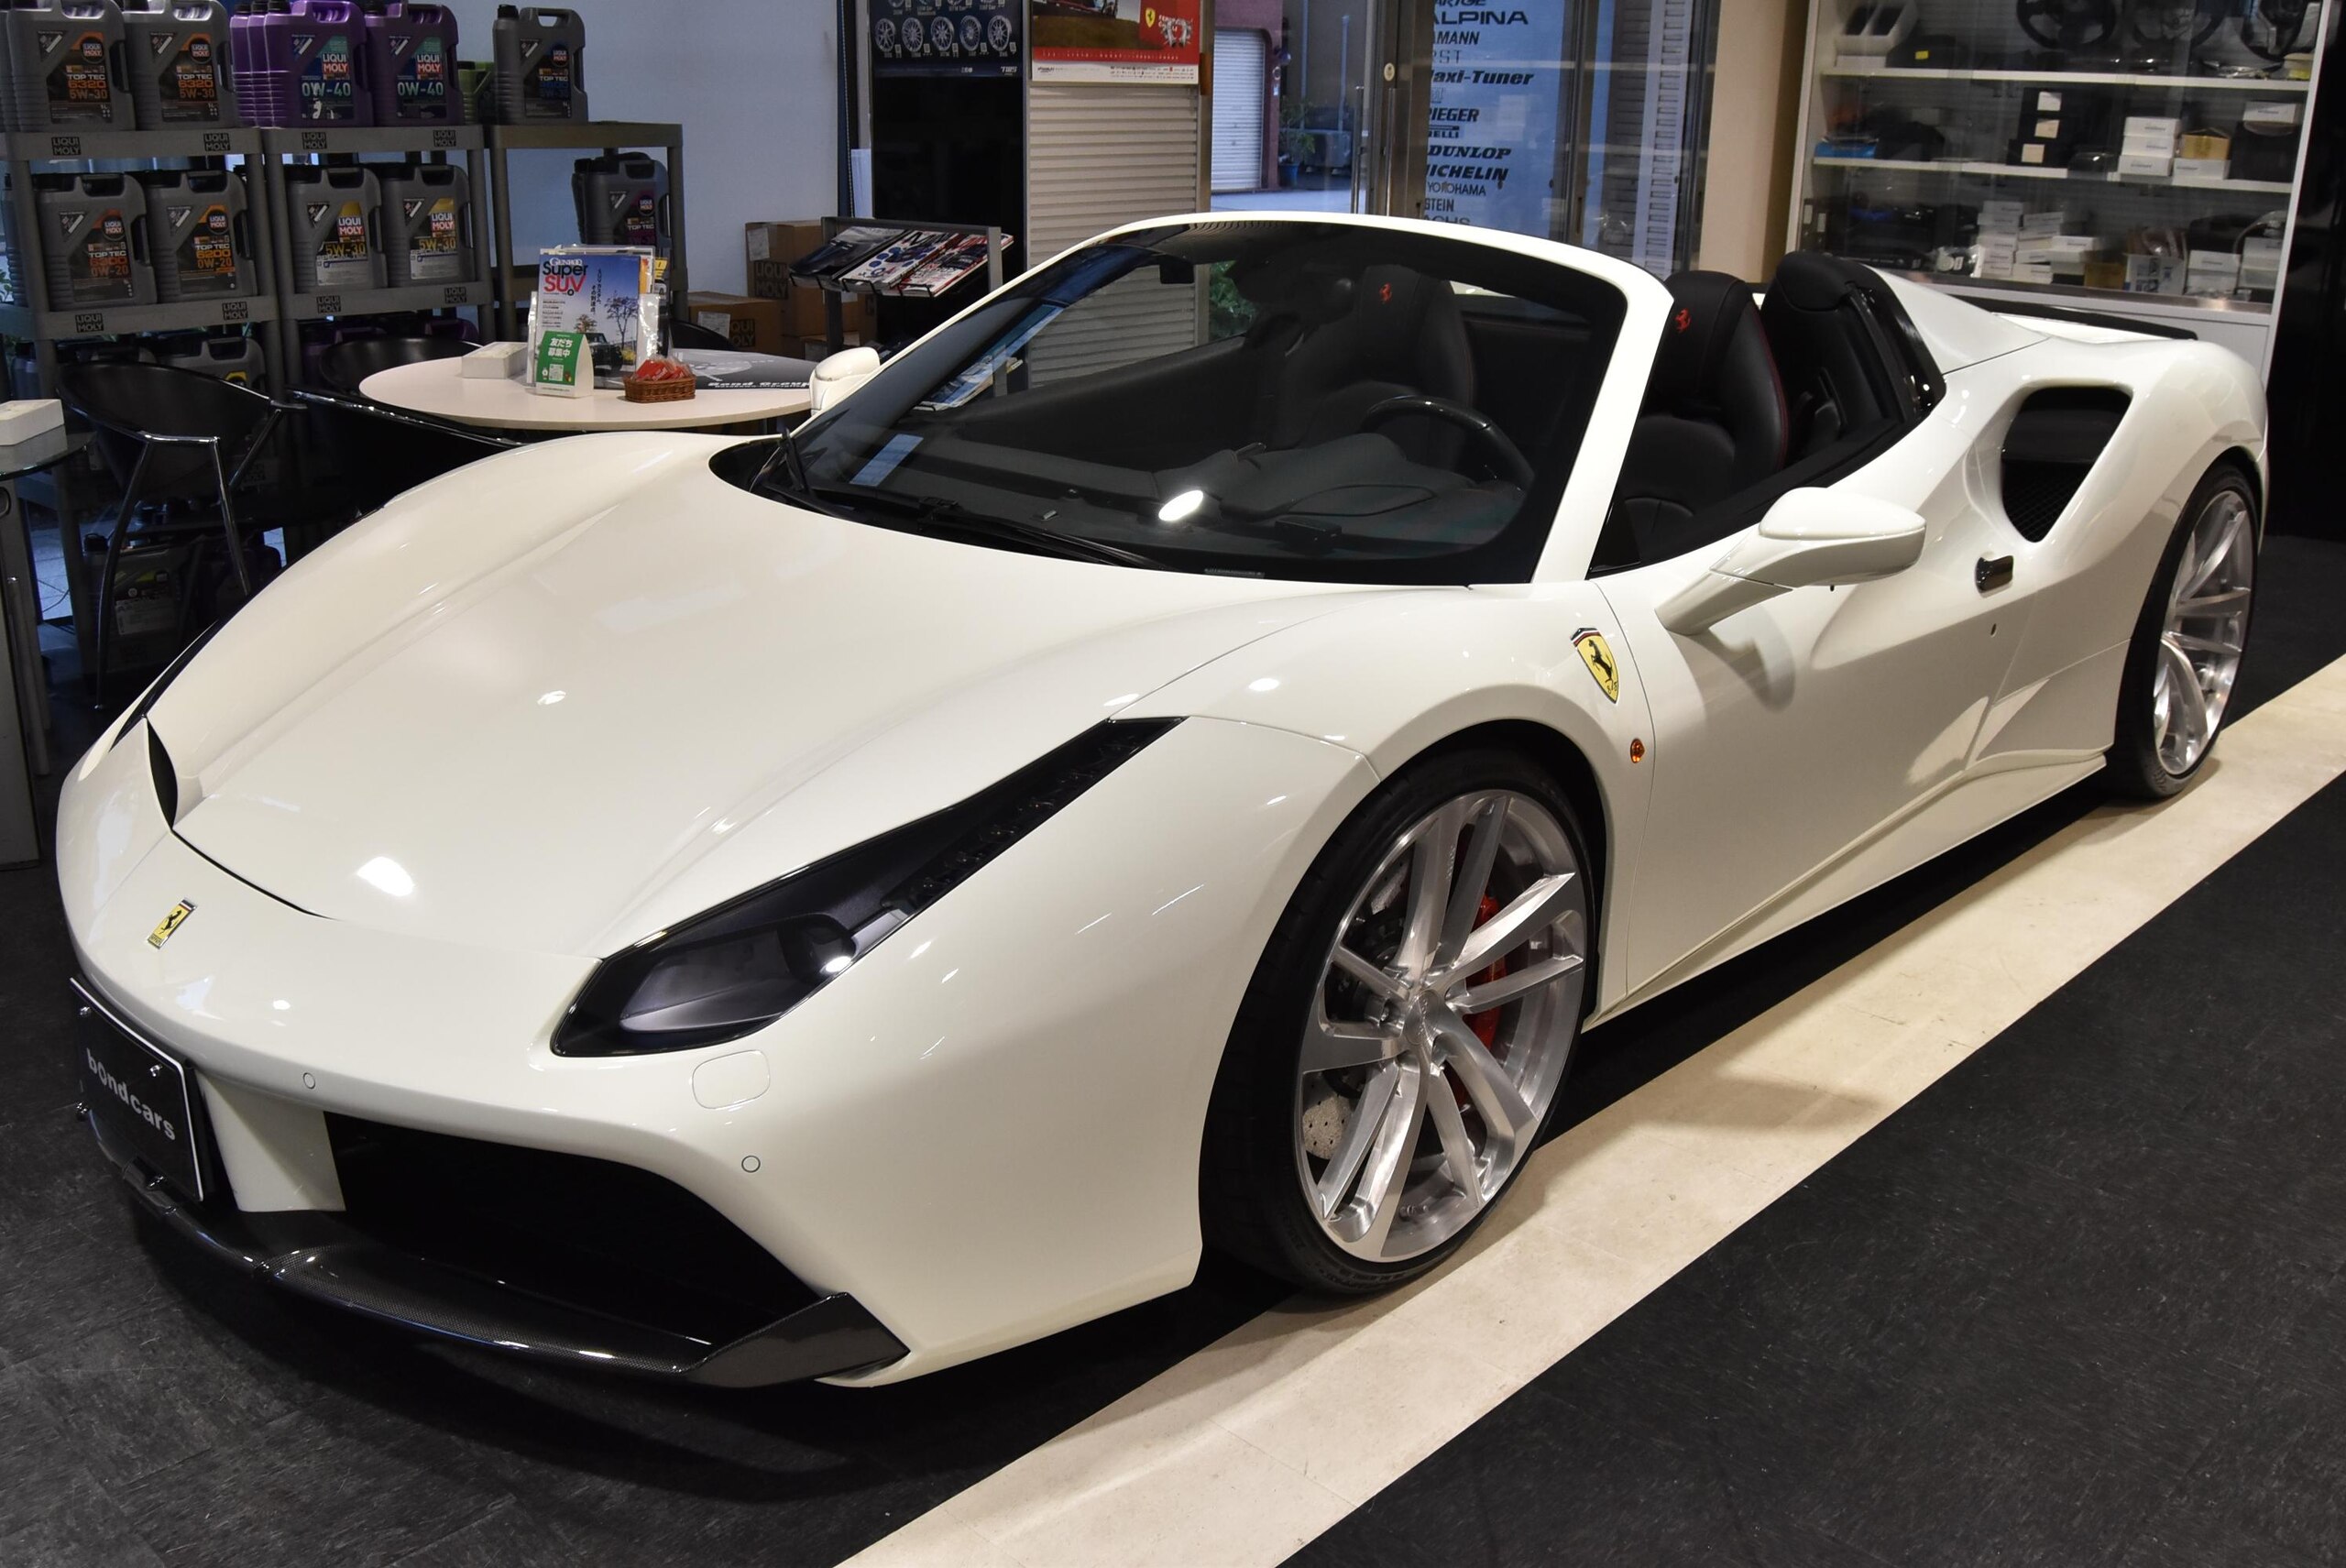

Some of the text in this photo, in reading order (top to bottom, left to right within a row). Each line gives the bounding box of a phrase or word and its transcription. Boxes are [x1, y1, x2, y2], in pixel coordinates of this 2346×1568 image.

[1433, 31, 1480, 45] MANN
[322, 54, 346, 62] LIQUI
[416, 54, 440, 63] LIQUI
[323, 63, 348, 72] MOLY
[417, 63, 441, 72] MOLY
[69, 81, 106, 89] 6320
[301, 82, 351, 97] 0W-40
[397, 82, 444, 97] 0W-40
[70, 89, 107, 100] 5W-30
[180, 88, 214, 99] 5W-30
[204, 134, 229, 143] LIQUI
[303, 132, 326, 140] LIQUI
[53, 137, 79, 146] LIQUI
[303, 140, 327, 149] MOLY
[434, 138, 456, 147] MOLY
[53, 146, 81, 155] MOLY
[205, 142, 230, 151] MOLY
[1427, 145, 1512, 159] DUNLOP
[337, 217, 361, 225] LIQUI
[432, 222, 455, 230] MOLY
[339, 226, 363, 236] MOLY
[419, 237, 456, 250] 5W-30
[196, 250, 231, 258] 6200
[325, 243, 366, 256] 5W-30
[197, 258, 233, 269] 0W-20
[543, 260, 588, 278] Super
[755, 262, 787, 280] LIQUI
[544, 275, 587, 291] SUV
[444, 287, 466, 295] LIQUI
[755, 280, 787, 298] MOLY
[318, 296, 340, 304] LIQUI
[445, 295, 466, 303] MOLY
[223, 302, 247, 311] LIQUI
[318, 304, 342, 313] MOLY
[76, 314, 103, 323] LIQUI
[224, 311, 247, 320] MOLY
[77, 323, 104, 333] MOLY
[731, 321, 754, 331] QUI
[549, 337, 573, 347] 友だち
[732, 334, 754, 346] OLY
